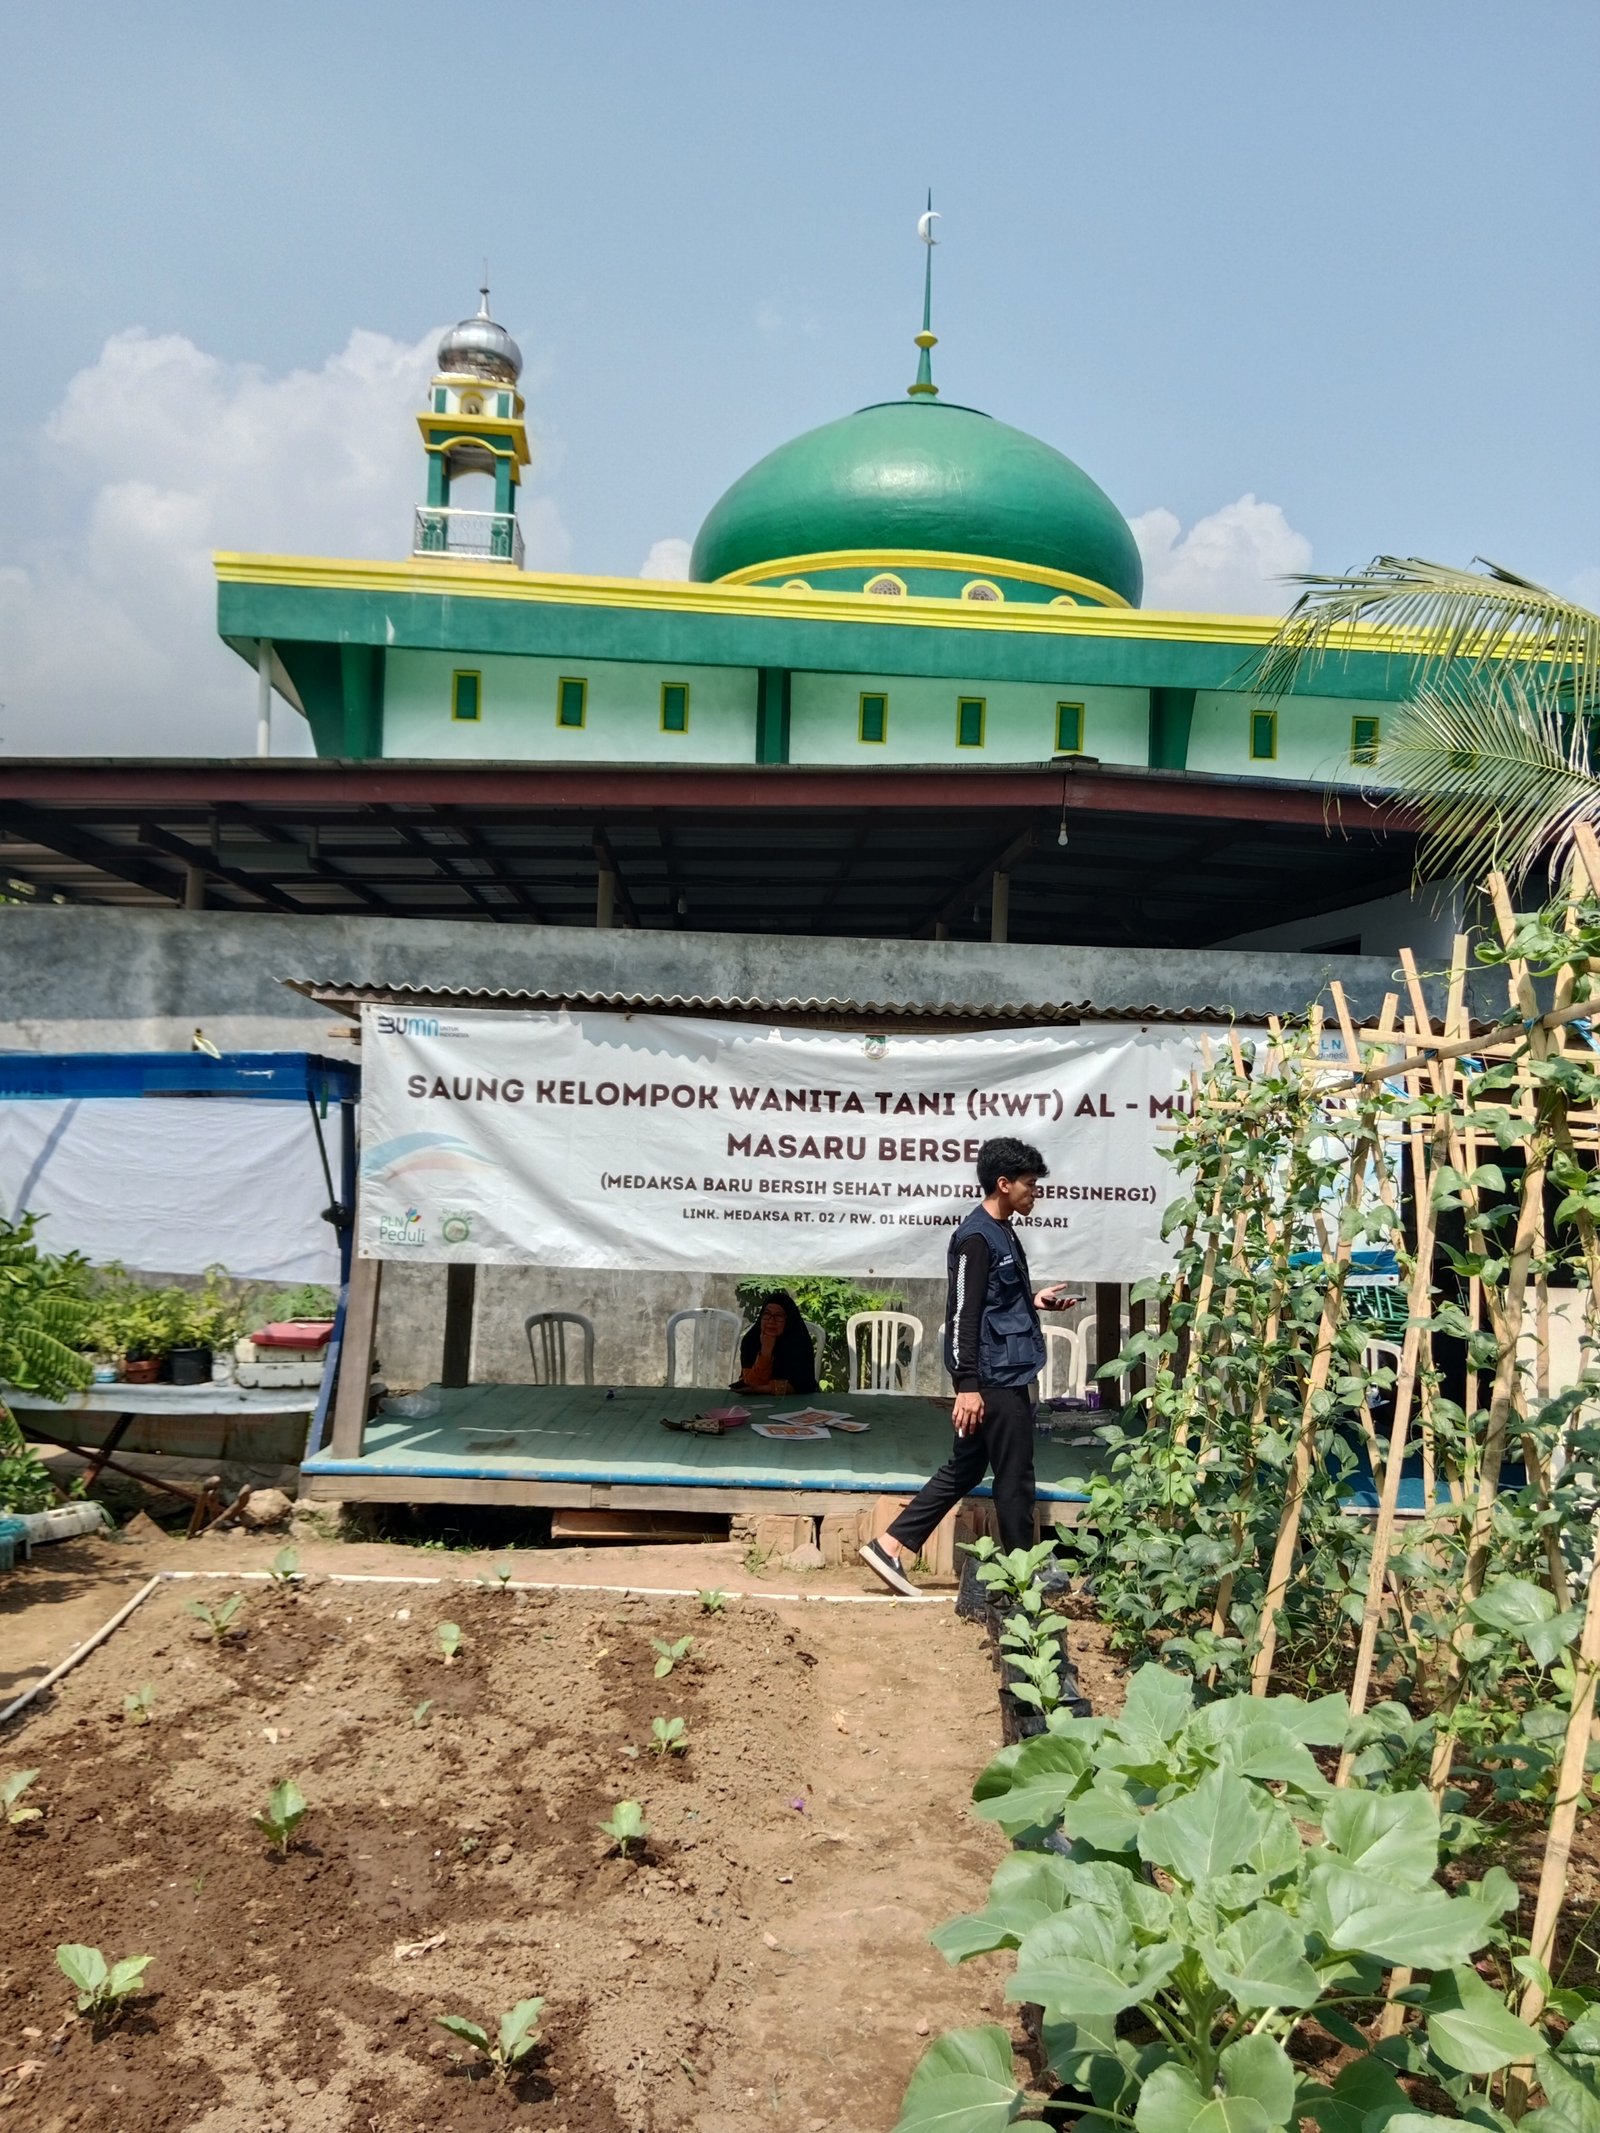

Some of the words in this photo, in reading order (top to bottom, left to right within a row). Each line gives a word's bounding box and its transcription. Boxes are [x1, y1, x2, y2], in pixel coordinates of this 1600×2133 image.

[1321, 1039, 1341, 1050] LN
[408, 1075, 524, 1102] SAUNG
[537, 1080, 718, 1109] KELOMPOK
[730, 1087, 864, 1113] WANITA
[875, 1092, 955, 1115] TANI
[967, 1088, 1064, 1121] (KWT)
[1074, 1094, 1115, 1117] AL
[728, 1133, 865, 1160] MASARU
[878, 1138, 980, 1163] BERSE
[601, 1172, 697, 1190] (MEDAKSA
[704, 1178, 752, 1192] BARU
[759, 1179, 826, 1194] BERSIH
[833, 1181, 891, 1196] SEHAT
[898, 1181, 982, 1198] MANDIRI
[381, 1216, 404, 1227] PLN
[683, 1209, 719, 1219] LINK.
[724, 1210, 790, 1221] MEDAKSA
[795, 1212, 814, 1222] RT.
[819, 1212, 834, 1223] 02
[839, 1213, 846, 1223] /
[850, 1213, 875, 1224] RW.
[880, 1214, 894, 1224] 01
[898, 1214, 968, 1226] KELURAH
[380, 1226, 425, 1243] Peduli
